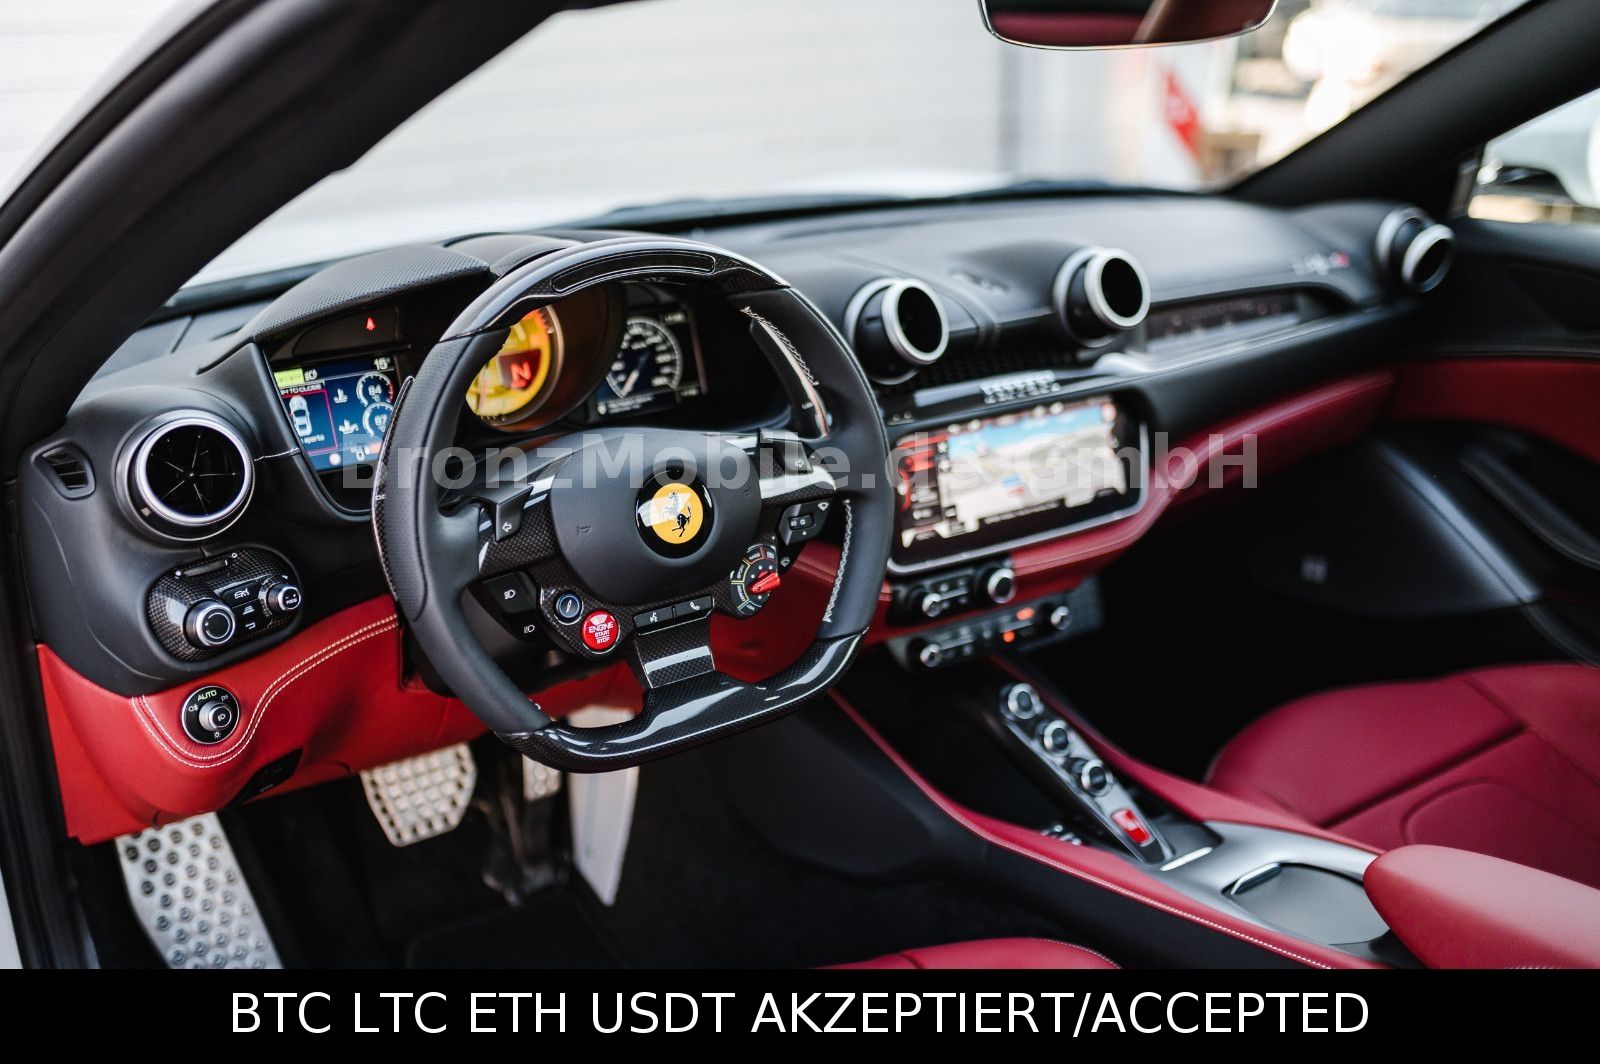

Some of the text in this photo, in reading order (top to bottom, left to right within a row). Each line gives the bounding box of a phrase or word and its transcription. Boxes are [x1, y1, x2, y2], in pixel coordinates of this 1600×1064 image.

[511, 361, 532, 384] N
[588, 622, 614, 633] ENGINE
[594, 630, 610, 638] START
[596, 637, 610, 645] STOP
[197, 690, 217, 701] AUTO
